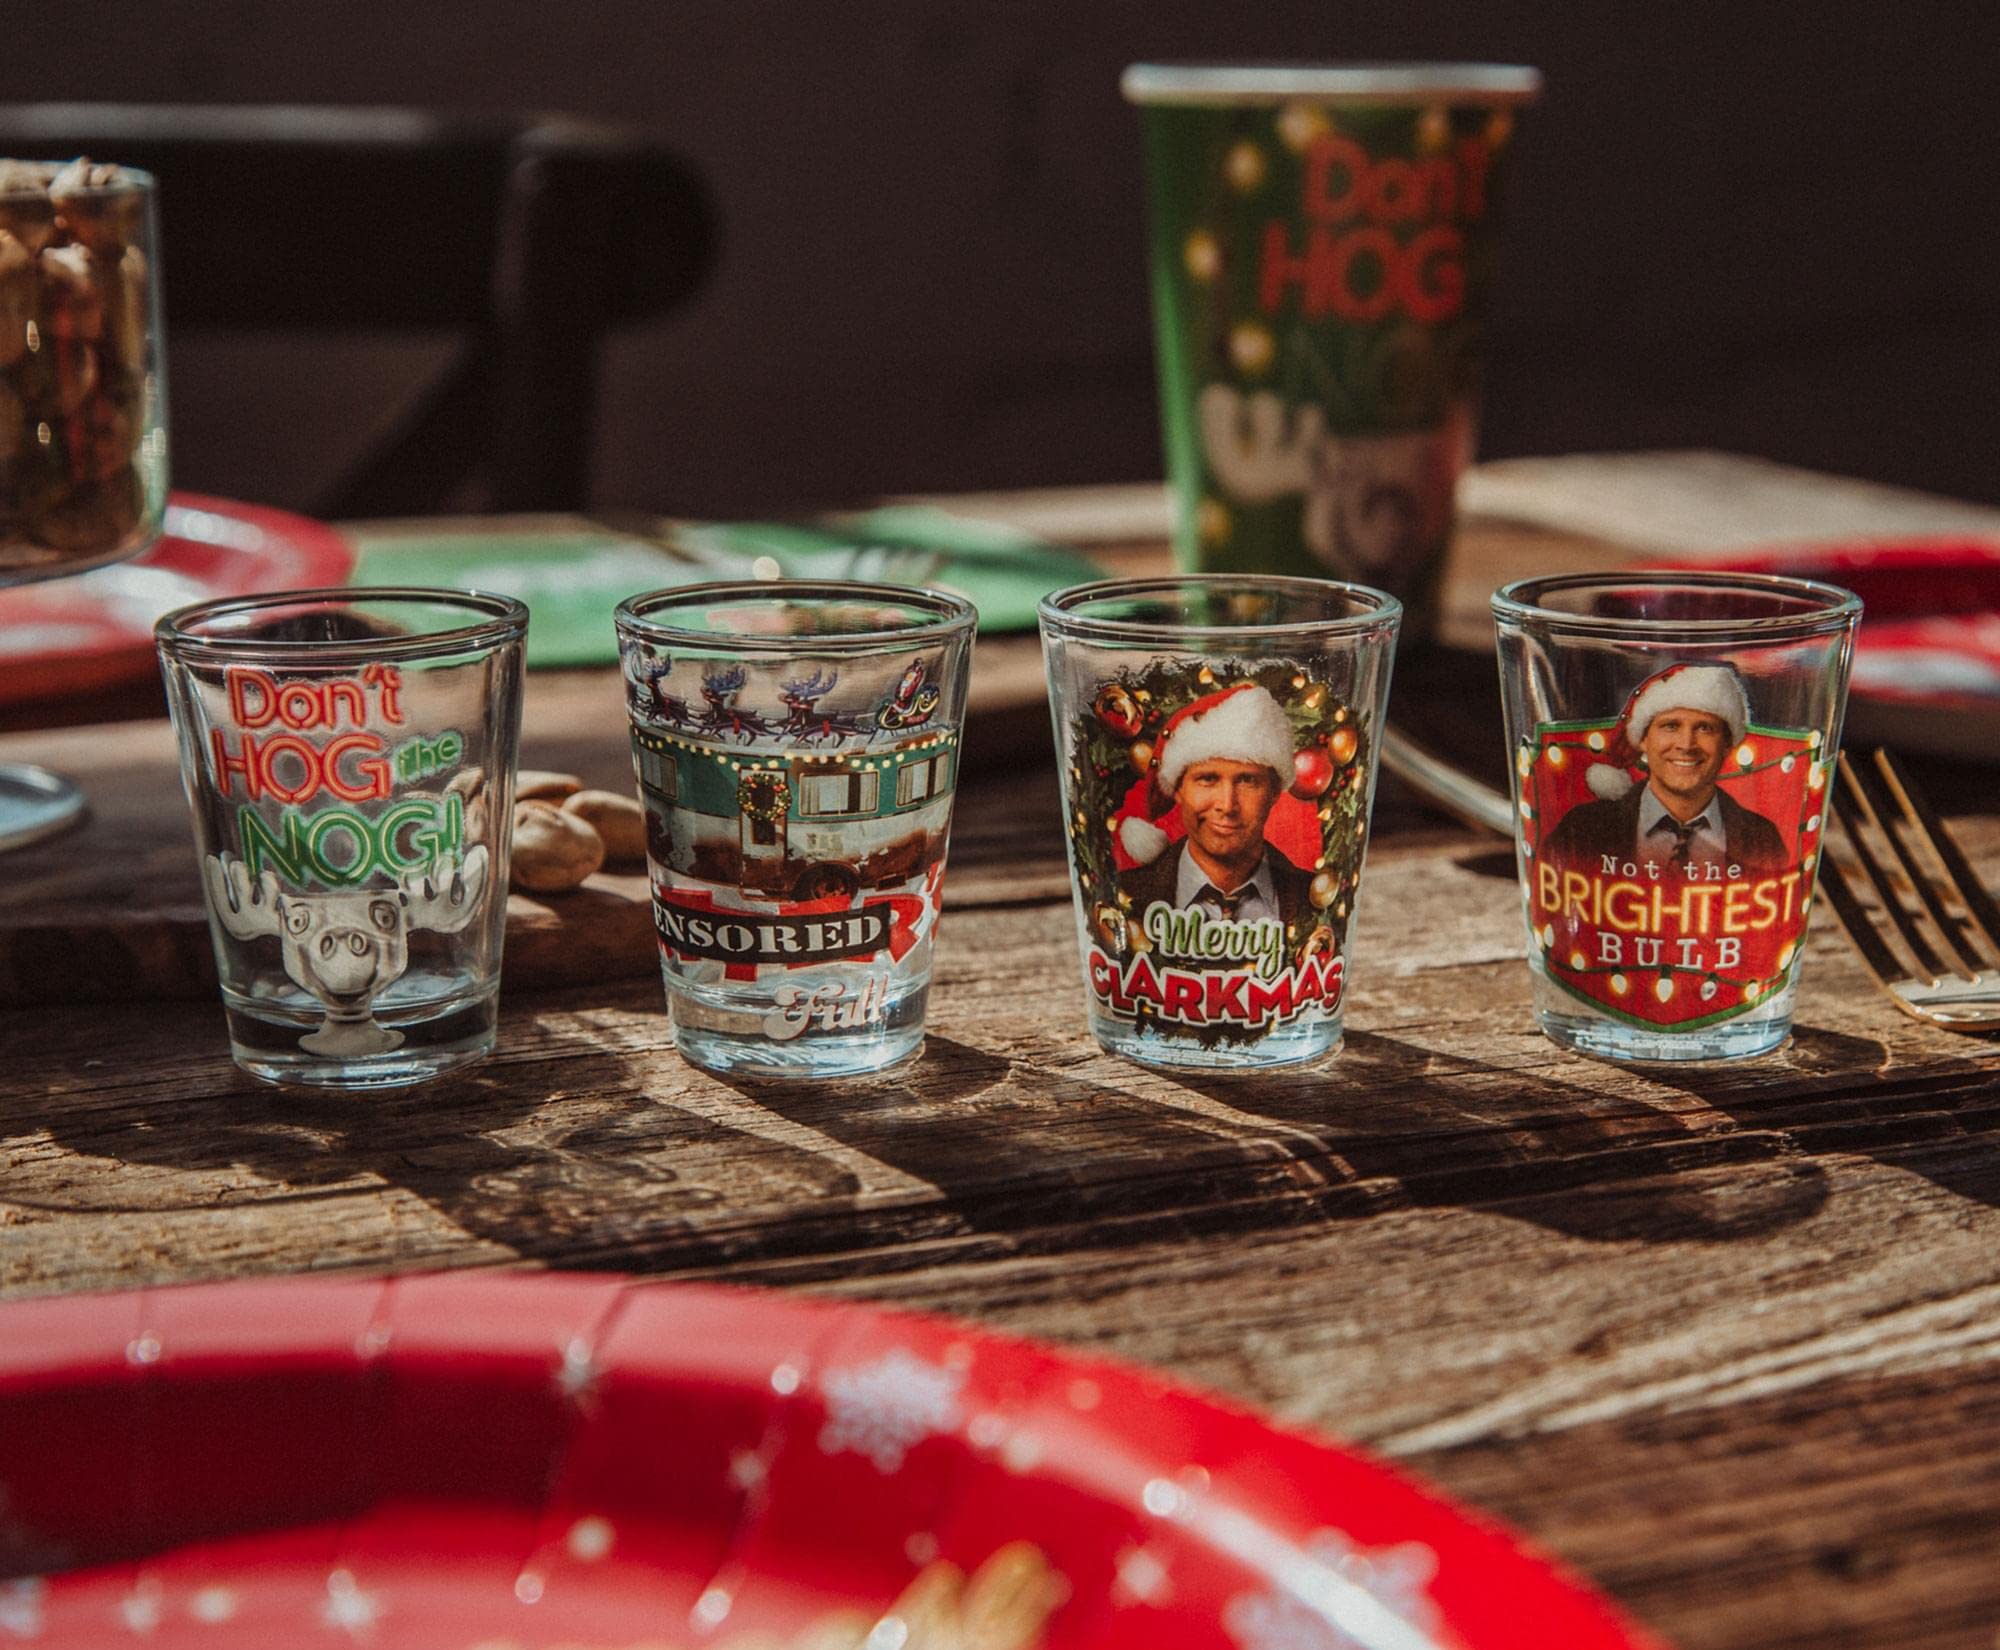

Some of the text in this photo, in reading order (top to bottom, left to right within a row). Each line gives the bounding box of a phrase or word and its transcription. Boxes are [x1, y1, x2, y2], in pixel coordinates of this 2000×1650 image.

[1258, 219, 1465, 322] HOG
[225, 663, 405, 730] Don't
[211, 728, 462, 804] HOG the
[239, 796, 463, 887] NOG!
[1601, 854, 1742, 881] Not the
[1538, 862, 1801, 934] BRIGHTEST
[1145, 902, 1284, 980] Merry
[1597, 931, 1741, 970] BULB
[763, 973, 889, 1040] Full
[1088, 948, 1344, 1026] CLARKMAS
